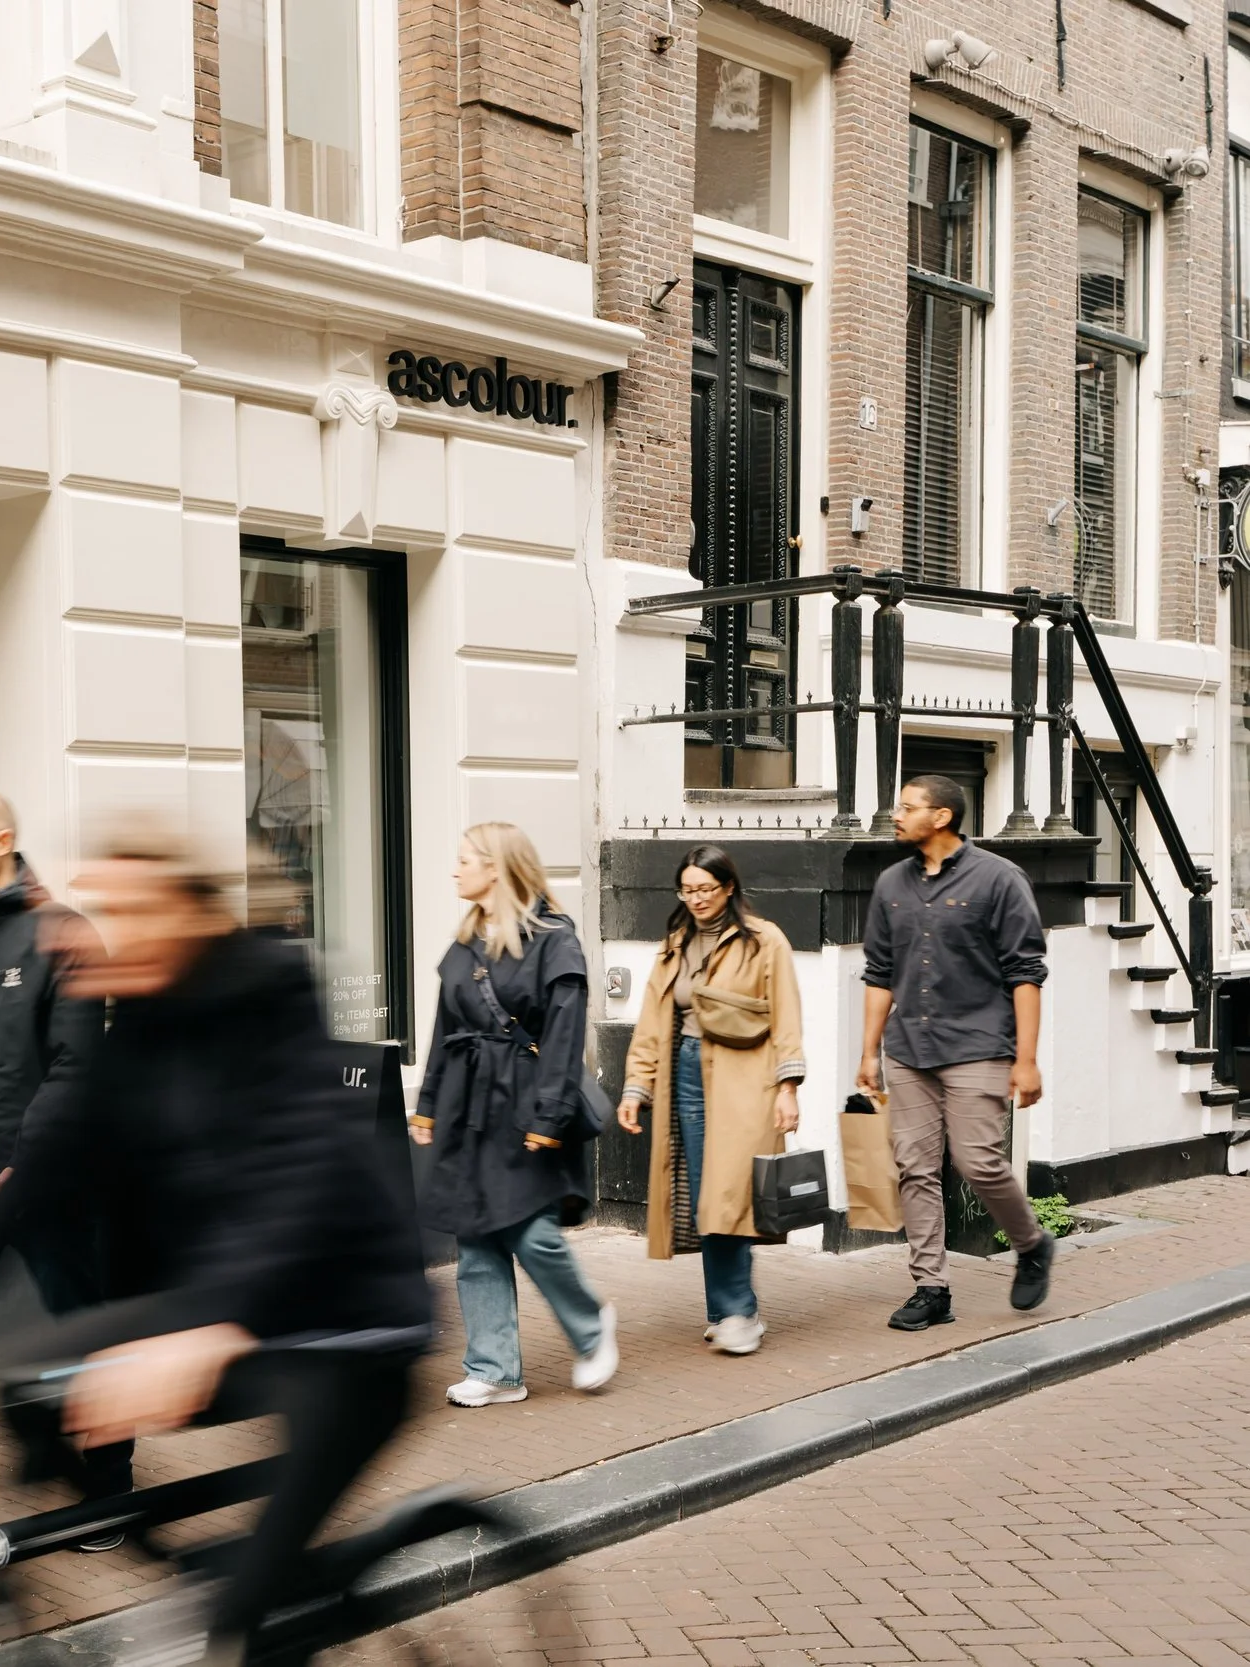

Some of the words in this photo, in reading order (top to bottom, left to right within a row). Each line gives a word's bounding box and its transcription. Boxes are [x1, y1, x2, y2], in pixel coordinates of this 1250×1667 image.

[387, 350, 579, 428] ascolour.
[340, 976, 364, 986] ITEMS
[365, 974, 382, 985] GET
[333, 991, 350, 1001] 20%
[351, 989, 367, 1000] OFF
[333, 1012, 344, 1021] 5+
[346, 1009, 370, 1020] ITEMS
[372, 1007, 388, 1018] GET
[333, 1025, 350, 1035] 25%
[352, 1023, 368, 1033] OFF
